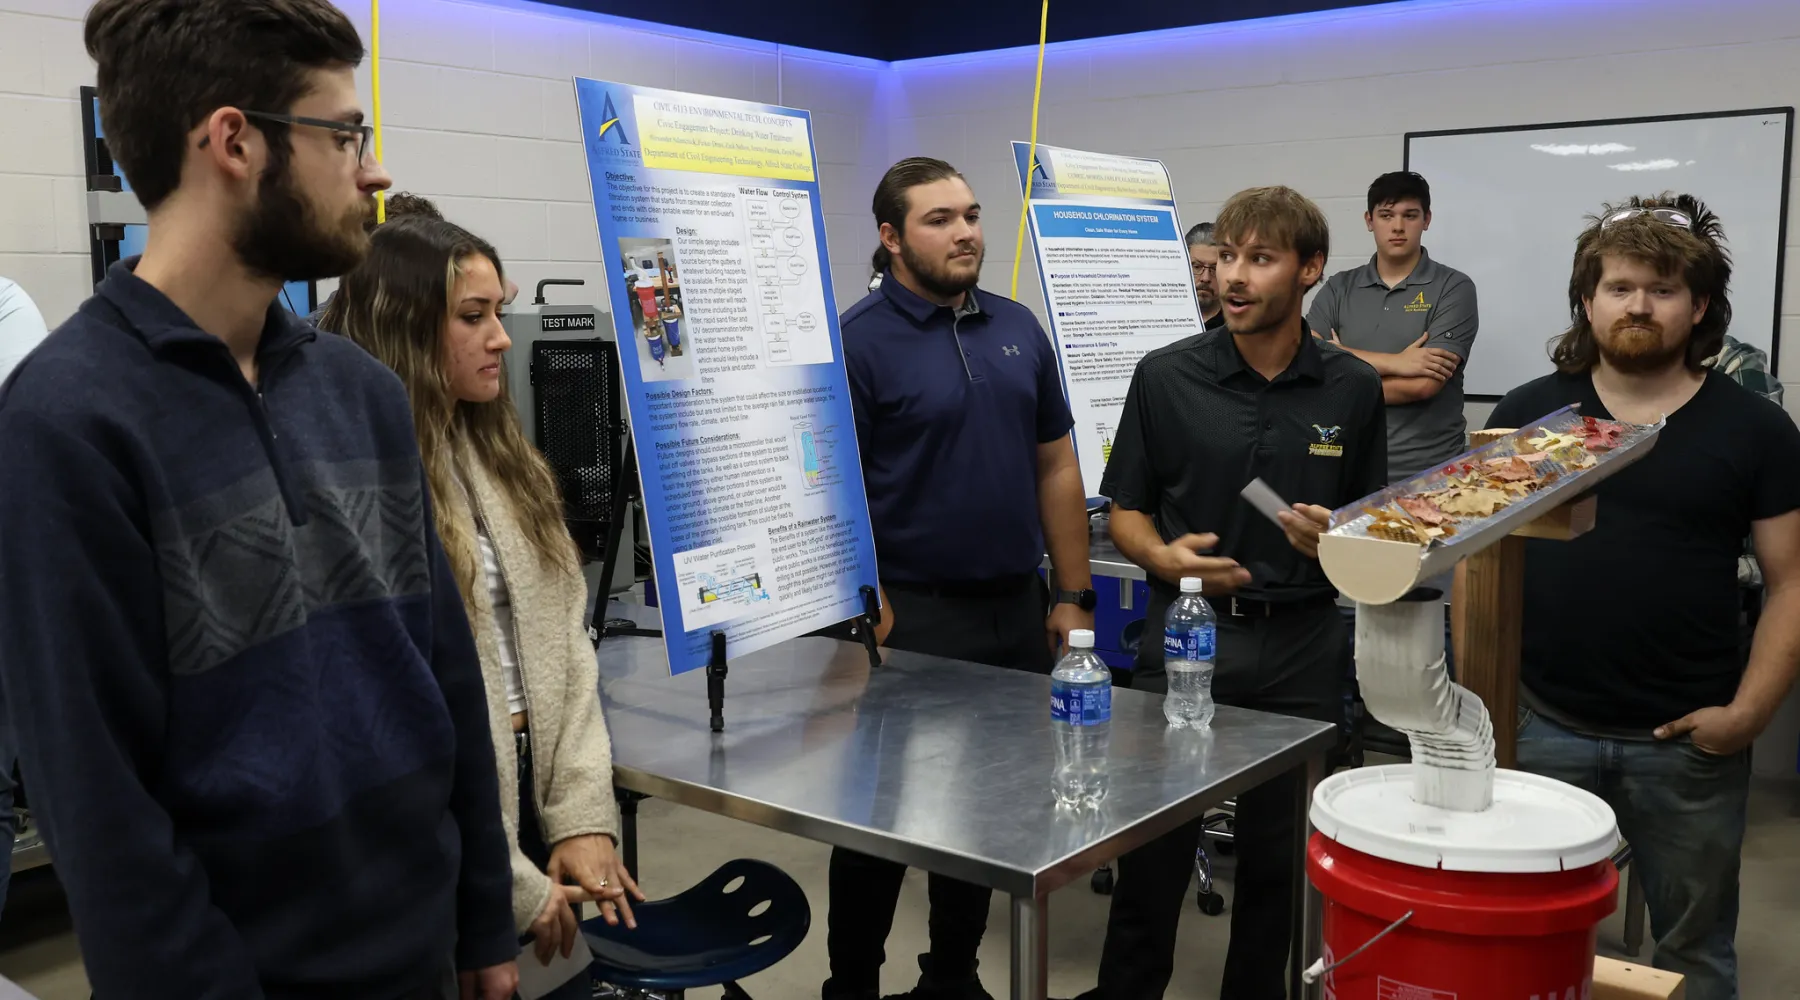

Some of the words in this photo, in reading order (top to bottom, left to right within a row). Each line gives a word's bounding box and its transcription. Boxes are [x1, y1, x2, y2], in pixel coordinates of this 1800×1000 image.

[652, 100, 670, 111] CIVIL
[672, 103, 688, 113] 6113
[688, 106, 743, 121] ENVIRONMENTAL
[762, 116, 792, 128] CONCEPTS
[656, 118, 673, 128] Civic
[674, 120, 709, 134] Engagement
[730, 127, 753, 139] Drinking
[754, 130, 768, 139] Water
[769, 132, 792, 142] Treatment
[620, 147, 642, 160] STATE
[643, 147, 678, 160] Department
[685, 151, 700, 161] Civil
[700, 153, 733, 166] Engineering
[765, 159, 779, 168] Alfred
[779, 161, 792, 169] State
[792, 162, 810, 173] College
[604, 171, 635, 183] Objective:
[618, 184, 642, 194] objective
[660, 187, 678, 196] project
[738, 187, 755, 195] Water
[772, 189, 791, 198] Control
[790, 191, 809, 200] System
[630, 194, 650, 204] system
[1053, 211, 1092, 220] HOUSEHOLD
[1093, 212, 1136, 222] CHLORINATION
[675, 227, 697, 236] Design:
[688, 237, 704, 246] simple
[704, 238, 720, 246] design
[688, 248, 706, 256] primary
[542, 318, 565, 328] TEST
[567, 317, 594, 327] MARK
[703, 317, 715, 325] rapid
[730, 344, 747, 352] system
[645, 391, 671, 401] Possible
[671, 389, 691, 400] Design
[654, 439, 680, 450] Possible
[680, 437, 699, 446] Future
[767, 523, 787, 535] Benefits
[797, 516, 819, 528] Rainwater
[819, 512, 836, 524] System
[692, 551, 709, 562] Water
[709, 545, 736, 558] Purification
[736, 541, 755, 552] Process
